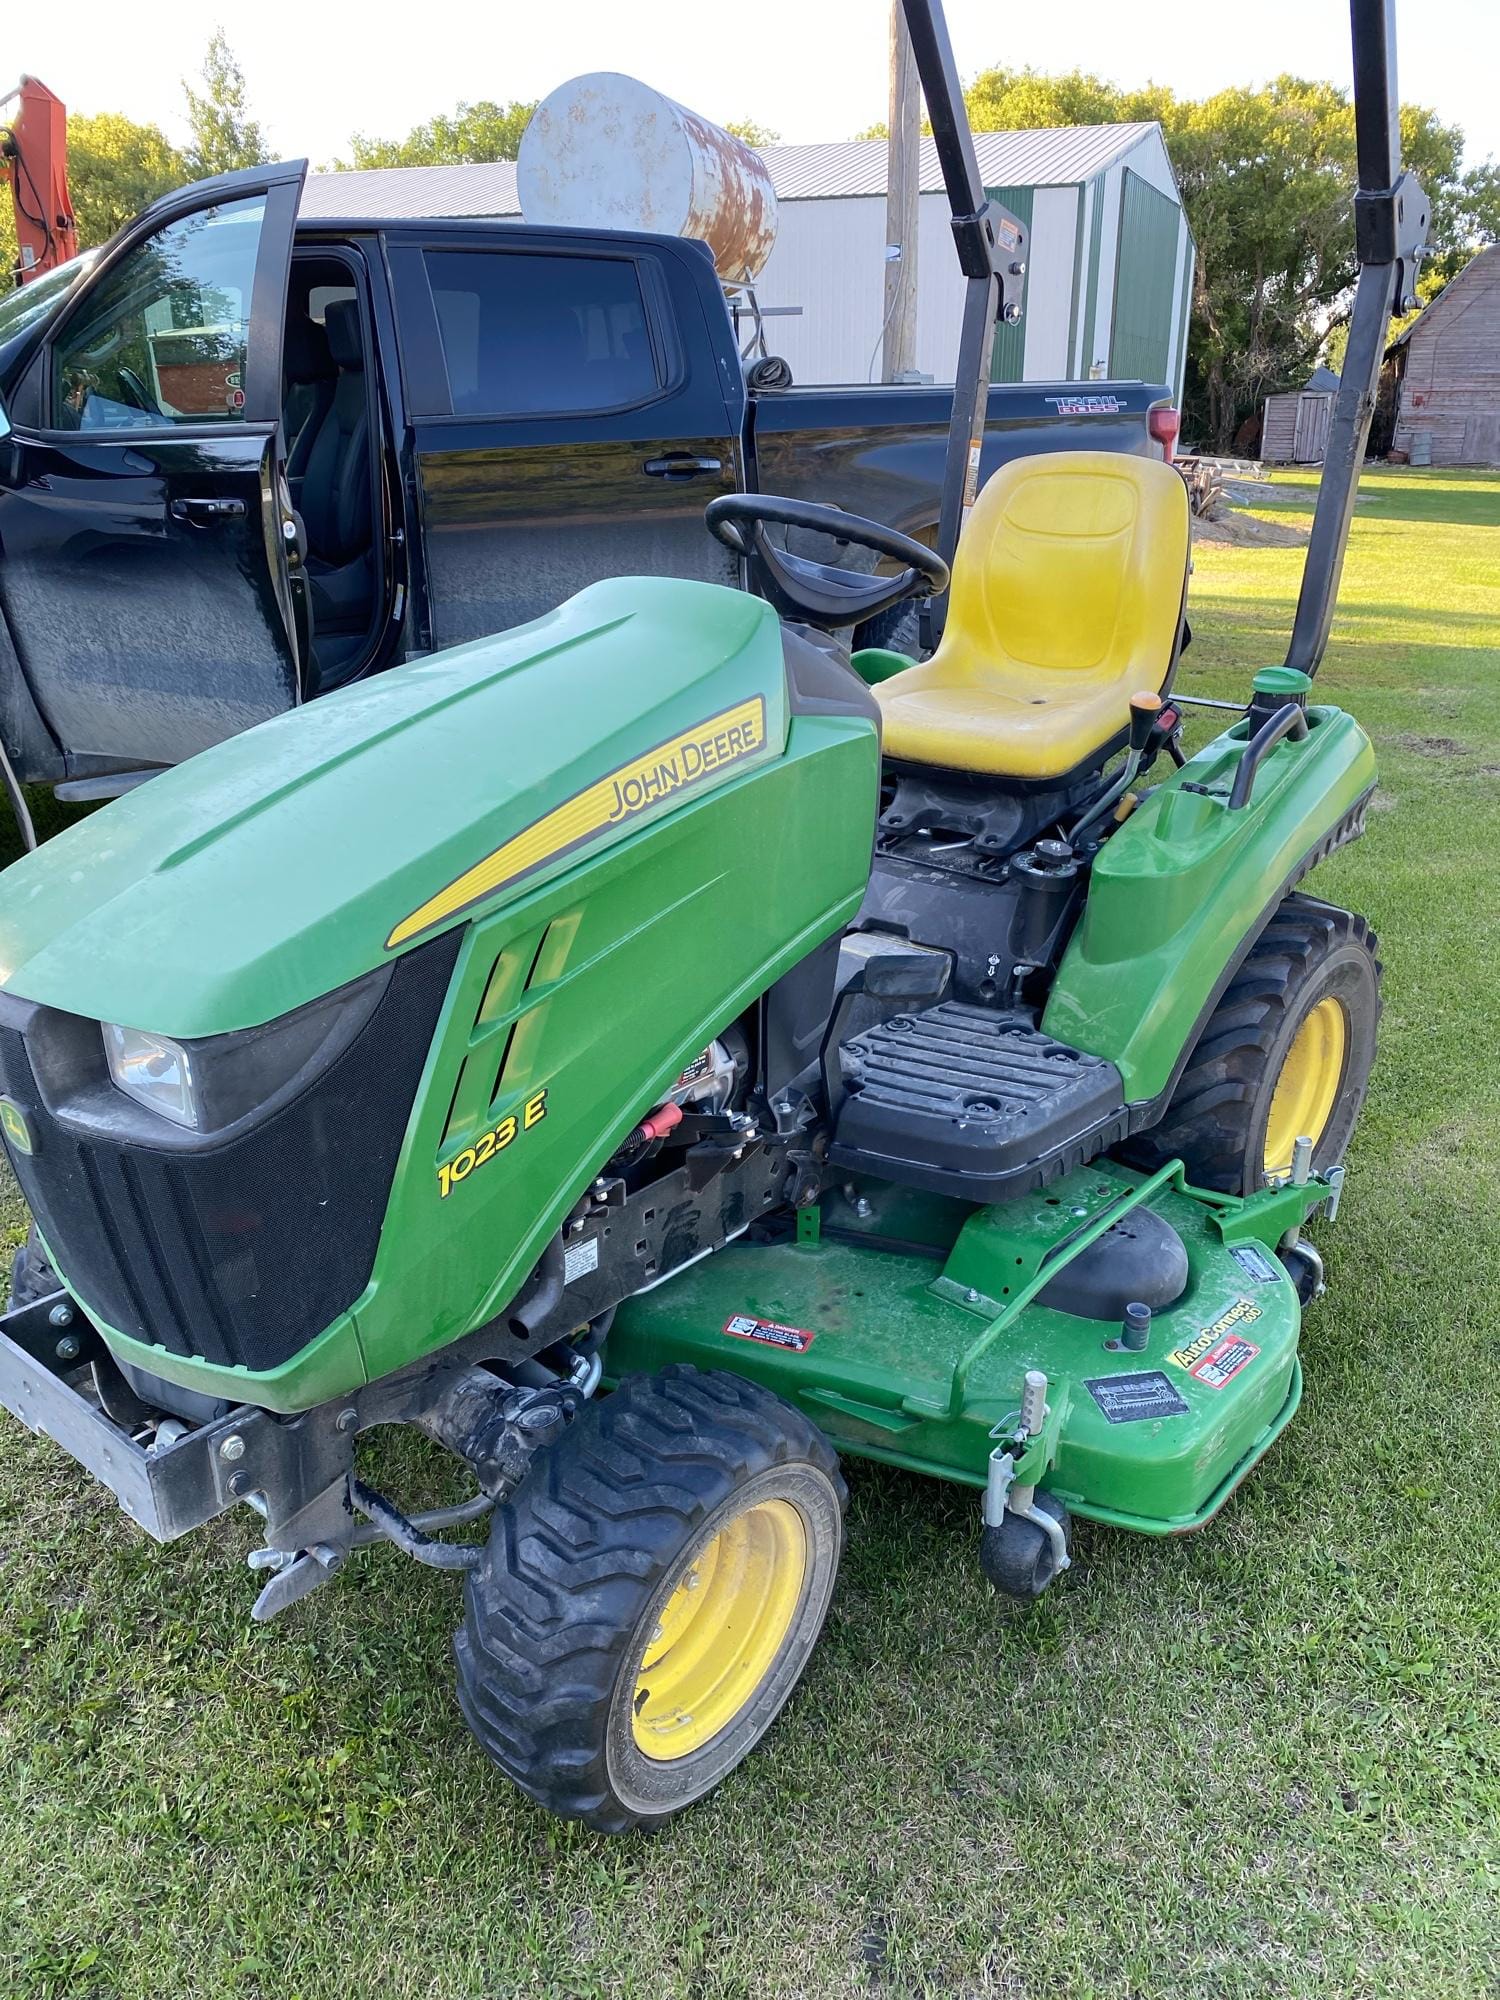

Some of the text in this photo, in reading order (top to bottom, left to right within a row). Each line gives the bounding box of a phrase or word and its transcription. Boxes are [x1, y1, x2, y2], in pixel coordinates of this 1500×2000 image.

[1044, 395, 1127, 407] TRAIL
[1058, 405, 1119, 414] BOSS
[609, 719, 757, 820] JOHN DEERE
[437, 1088, 548, 1199] 1023 E
[1240, 1307, 1263, 1324] 60D
[774, 1324, 800, 1334] DANGER
[1174, 1298, 1256, 1369] AutoConnect
